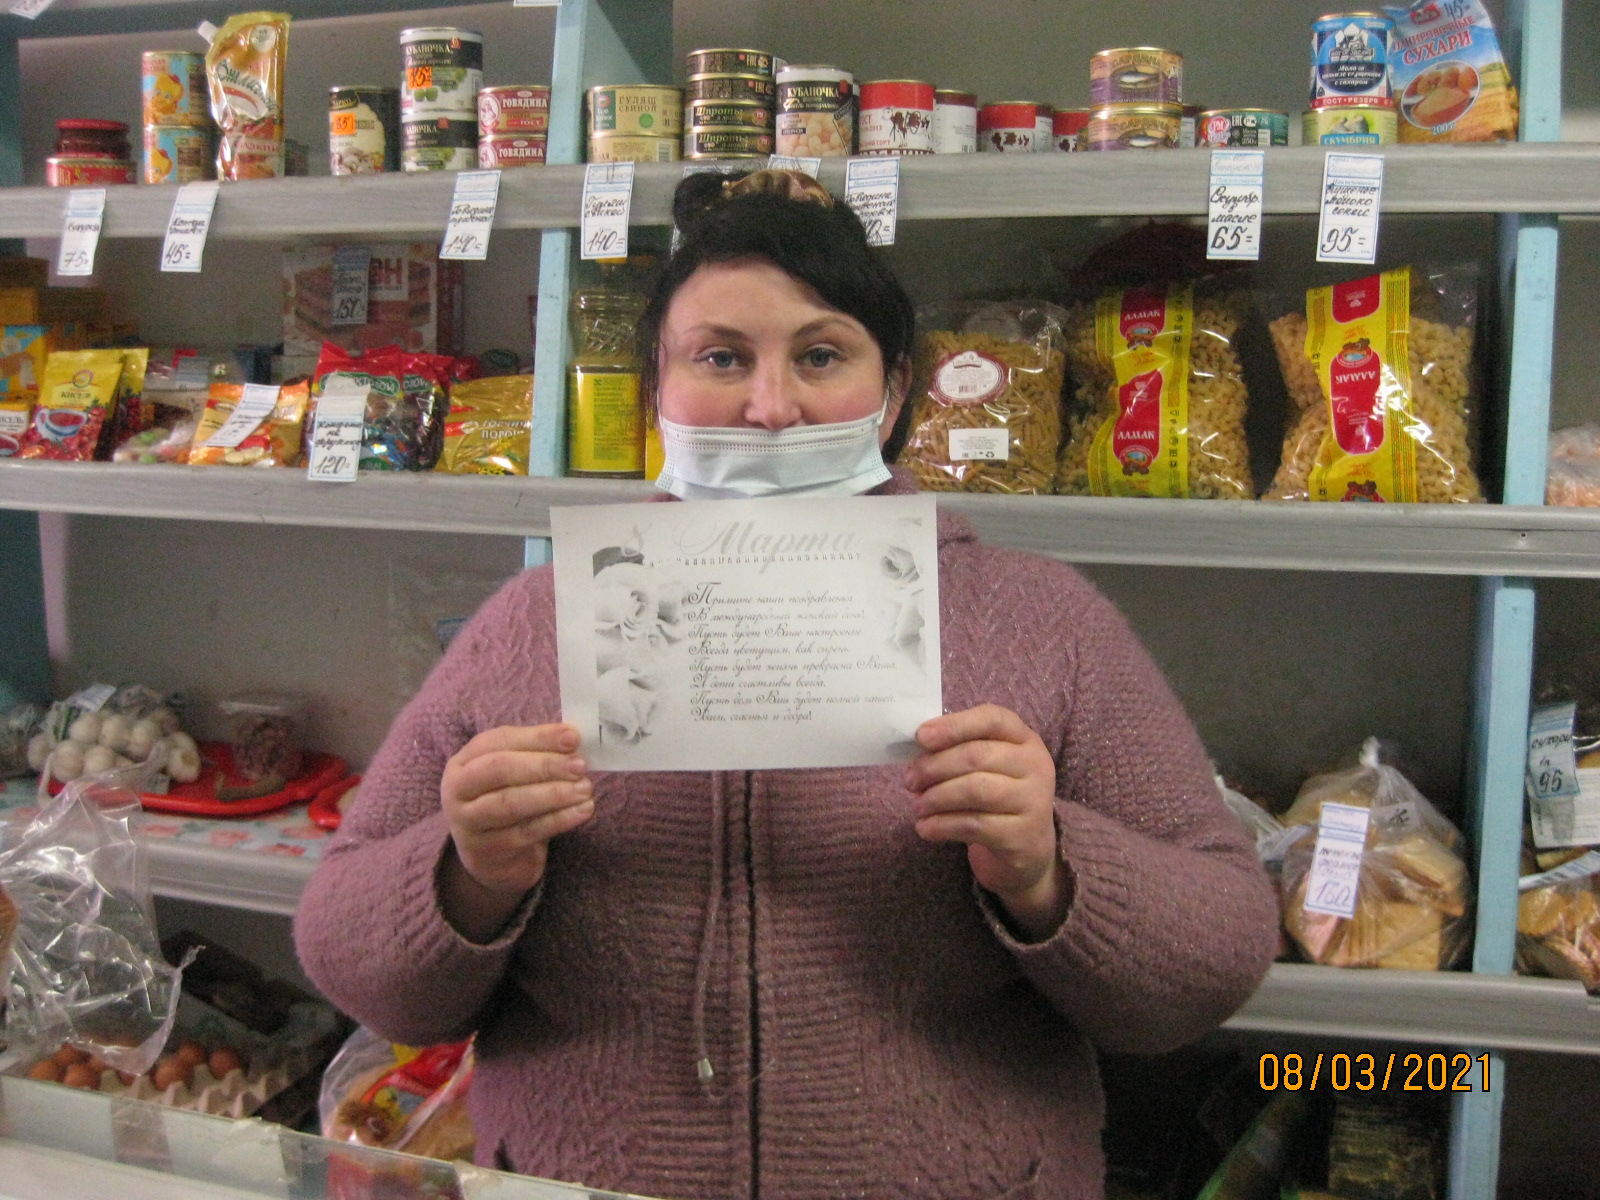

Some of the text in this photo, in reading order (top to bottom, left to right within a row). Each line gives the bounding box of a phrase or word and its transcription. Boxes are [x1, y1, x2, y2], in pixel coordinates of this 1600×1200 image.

[1403, 29, 1473, 65] СУХАРИ
[787, 86, 840, 98] КУБАНОЧКА
[502, 98, 548, 109] ГОВЯДИНА
[618, 96, 657, 105] ГУЛЯШ
[618, 105, 657, 113] СВИНОЙ
[695, 107, 744, 118] Шпроты
[499, 147, 544, 158] ГОВЯДИНА
[1124, 310, 1161, 321] АЛМАК
[1117, 430, 1156, 440] АЛМАК
[673, 520, 858, 574] Марта
[688, 582, 753, 608] Примите
[688, 623, 727, 644] Пусть
[732, 625, 761, 644] будет
[689, 657, 728, 677] Пусть
[732, 658, 762, 677] будет
[690, 690, 730, 711] Пусть
